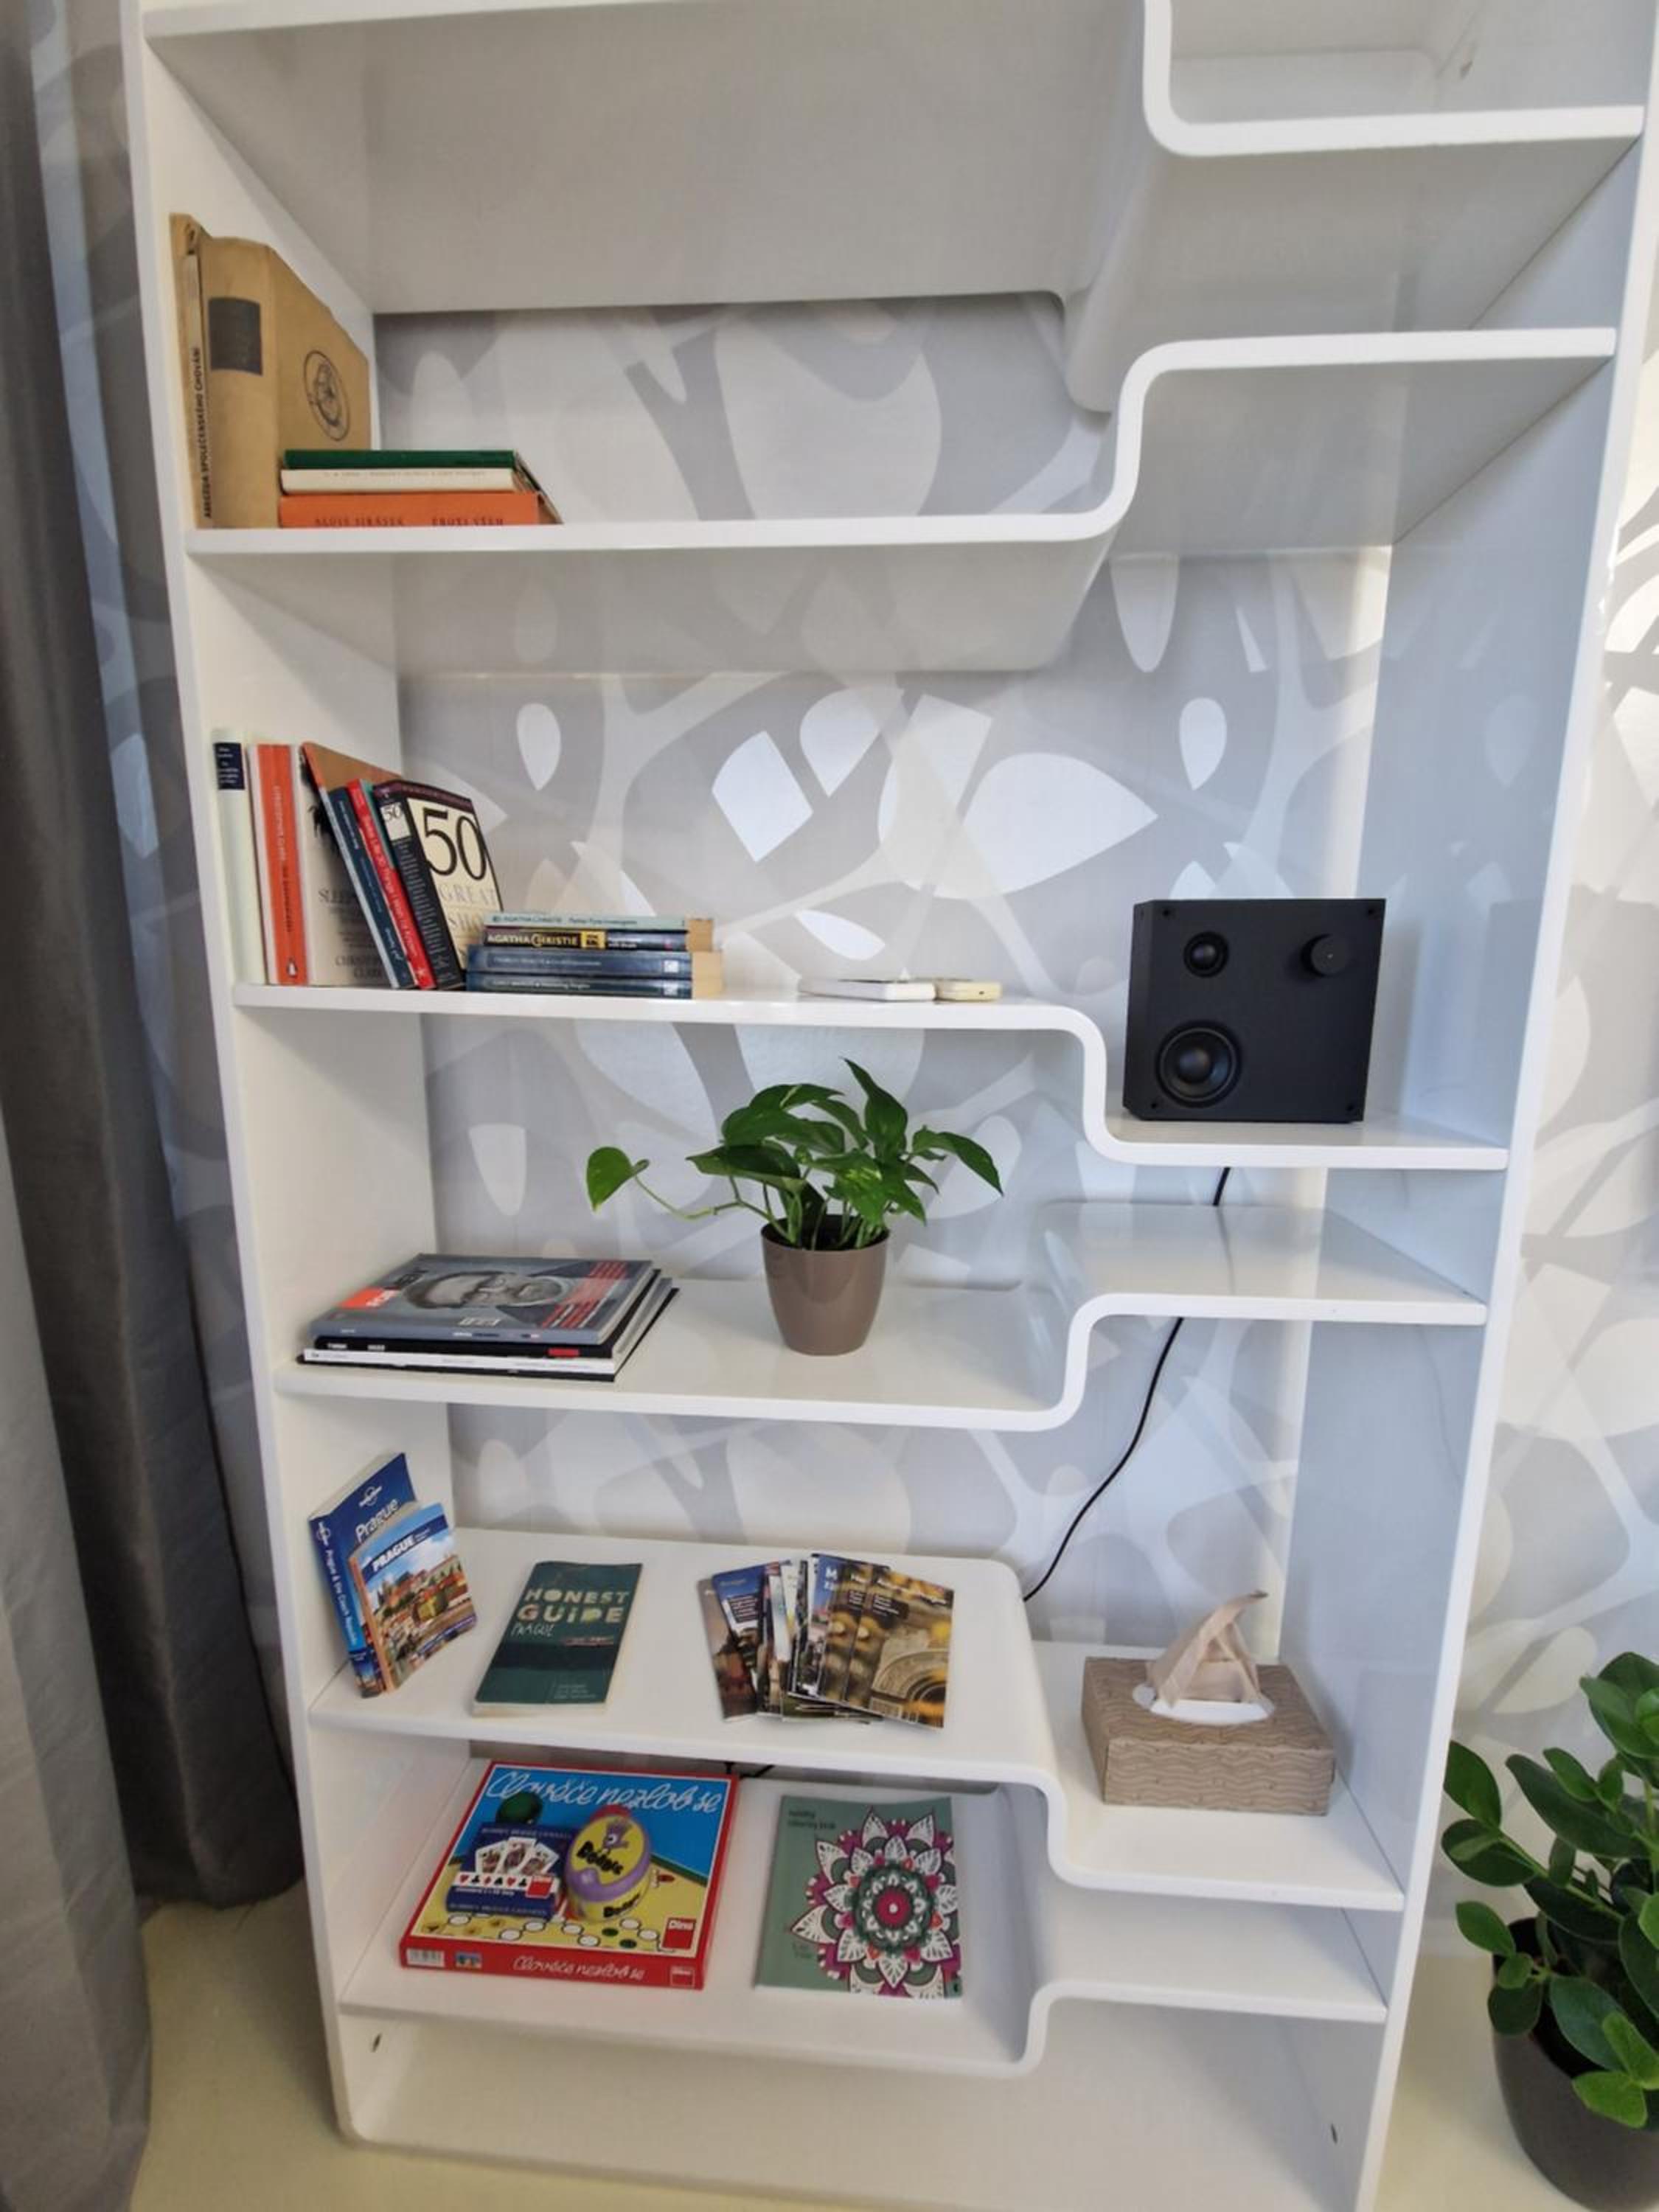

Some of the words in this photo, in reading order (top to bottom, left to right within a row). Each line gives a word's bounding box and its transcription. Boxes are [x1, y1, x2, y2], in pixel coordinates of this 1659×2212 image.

[383, 803, 401, 821] 50
[422, 807, 487, 880] 50
[439, 884, 497, 906] GREAT
[487, 934, 530, 945] AGATHA
[531, 933, 578, 947] CHRISTIE
[355, 1499, 398, 1543] Prague
[371, 1534, 414, 1571] PRAGUE
[524, 1587, 629, 1604] HONEST
[517, 1604, 625, 1623] GUIDE
[692, 1792, 723, 1812] se
